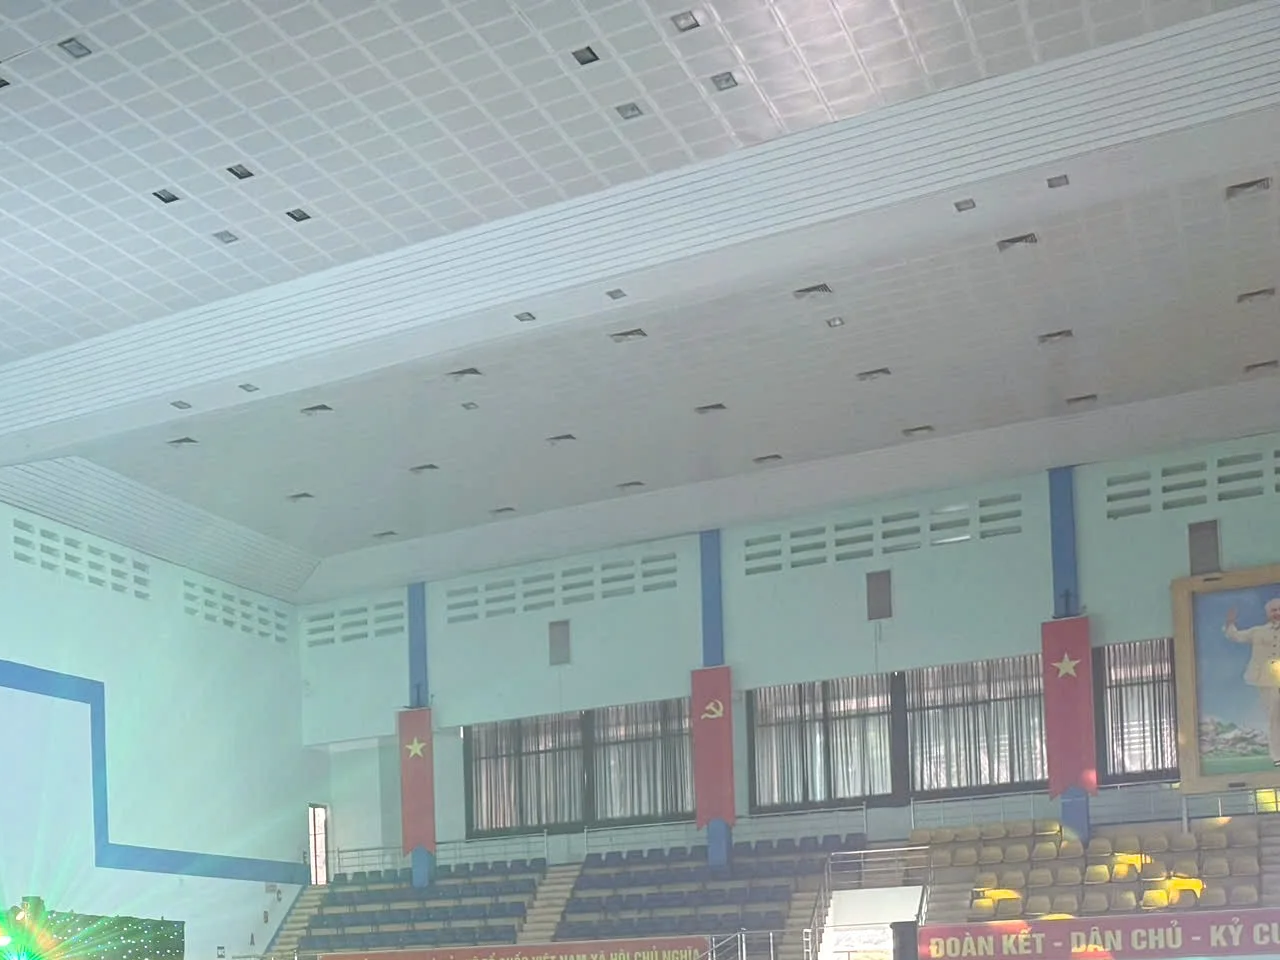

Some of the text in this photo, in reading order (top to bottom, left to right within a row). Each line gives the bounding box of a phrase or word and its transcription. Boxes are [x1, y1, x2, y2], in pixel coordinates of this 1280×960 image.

[929, 931, 995, 958] ĐOÀN
[1002, 927, 1046, 955] KẾT
[1070, 926, 1122, 953] DÂN
[1131, 920, 1183, 950] CHỦ
[1210, 916, 1244, 947] KỶ
